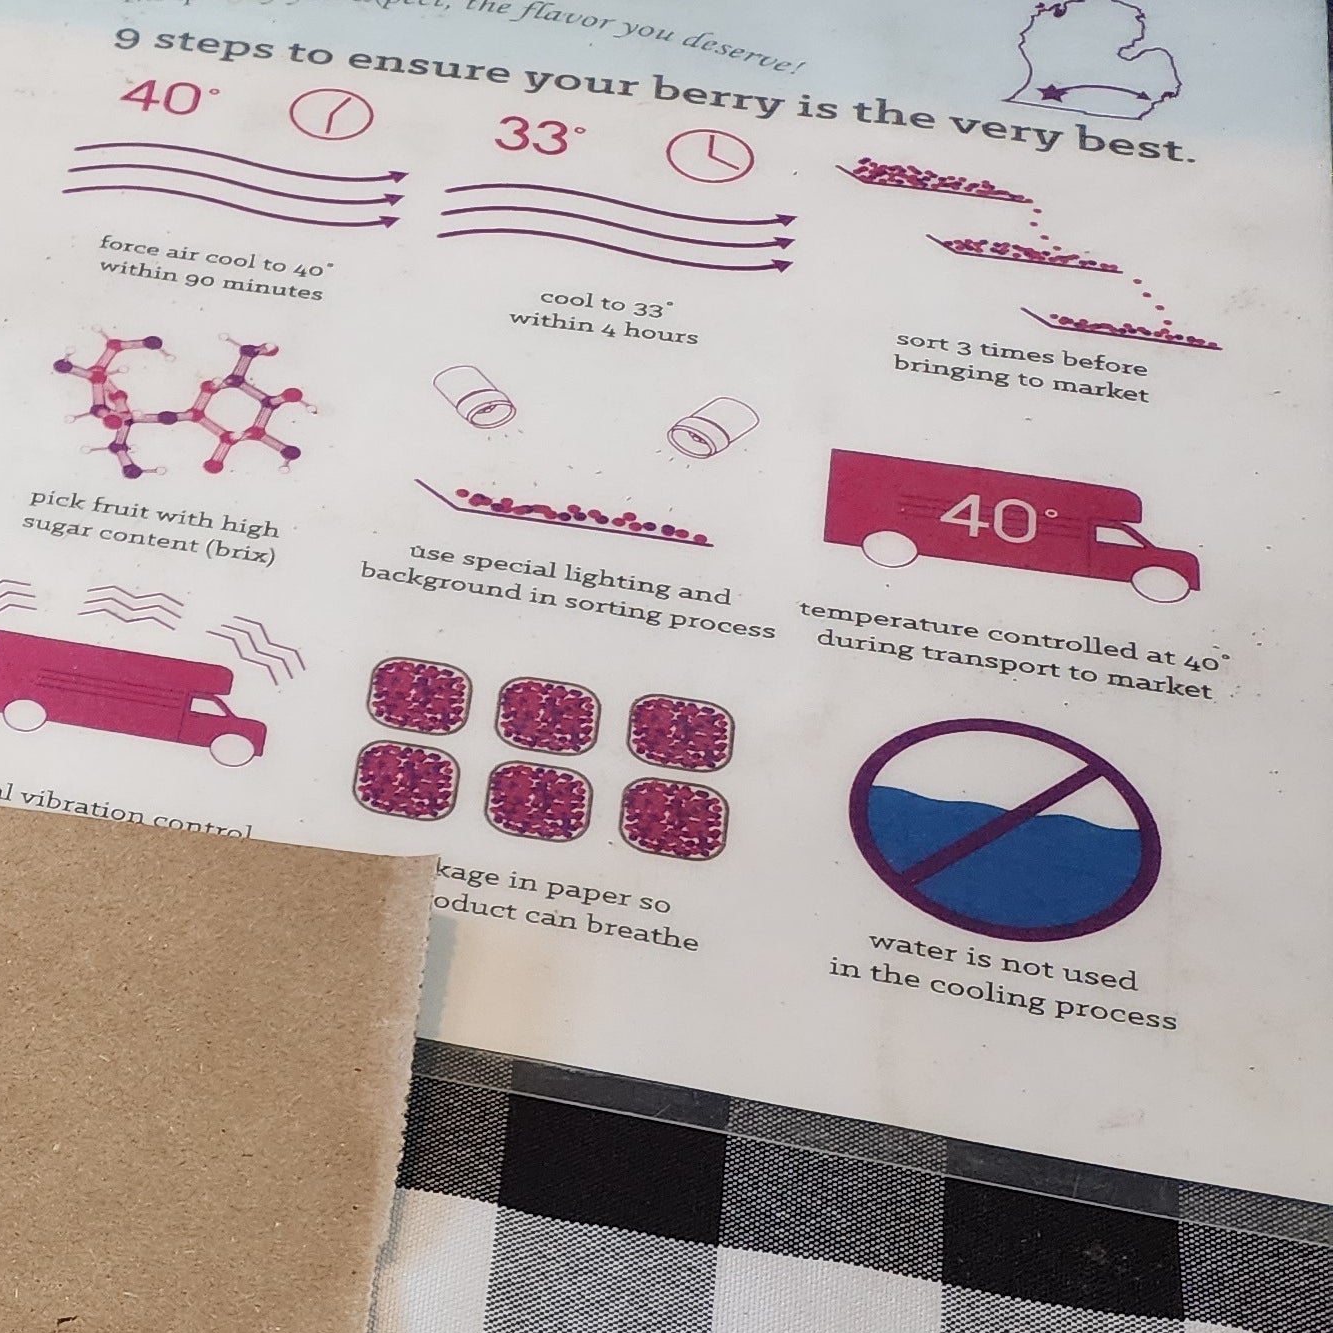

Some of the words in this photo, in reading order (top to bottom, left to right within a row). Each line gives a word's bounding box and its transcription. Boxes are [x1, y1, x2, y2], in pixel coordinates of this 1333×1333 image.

[510, 1, 615, 29] flavor
[614, 22, 674, 41] you
[682, 32, 806, 74] deserve!
[115, 28, 140, 49] 9
[155, 33, 273, 62] steps
[289, 44, 333, 64] to
[349, 54, 510, 83] ensure
[525, 71, 639, 96] your
[653, 75, 785, 119] berry
[798, 95, 837, 119] is
[853, 98, 935, 129] the
[949, 117, 1063, 152] very
[1076, 124, 1195, 163] best.
[100, 235, 159, 256] force
[166, 249, 199, 261] air
[206, 254, 255, 268] cool
[264, 259, 286, 272] to
[101, 262, 177, 282] within
[185, 274, 214, 287] 90
[223, 280, 322, 300] minutes
[541, 293, 593, 308] cool
[601, 298, 625, 311] to
[510, 313, 593, 332] within
[602, 324, 615, 337] 4
[624, 322, 698, 344] hours
[895, 354, 1009, 387] bringing
[1018, 374, 1044, 387] to
[1054, 380, 1148, 403] market
[897, 335, 948, 351] sort
[957, 342, 971, 355] 3
[981, 344, 1054, 363] times
[1063, 350, 1147, 376] before
[30, 493, 85, 509] pick
[93, 497, 149, 519] fruit
[157, 511, 212, 528] with
[221, 515, 278, 539] high
[23, 518, 93, 537] sugar
[100, 530, 198, 552] content
[206, 539, 275, 567] (brix)
[361, 560, 523, 601] background
[530, 592, 556, 606] in
[565, 598, 662, 626] sorting
[669, 614, 775, 638] process
[411, 546, 454, 562] use
[463, 555, 555, 578] special
[565, 564, 671, 600] lighting
[679, 588, 730, 605] and
[800, 602, 980, 639] temperature
[988, 630, 1138, 660] controlled
[1147, 651, 1175, 665] at
[818, 629, 914, 661] during
[923, 646, 1060, 677] transport
[1069, 666, 1097, 682] to
[1108, 674, 1212, 699] market
[20, 789, 144, 825] vibration
[509, 876, 537, 891] in
[546, 882, 631, 906] paper
[640, 898, 670, 913] so
[434, 894, 516, 920] oduct
[526, 911, 577, 929] can
[588, 913, 698, 951] breathe
[870, 936, 957, 962] water
[967, 947, 991, 967] is
[1002, 958, 1053, 978] not
[1063, 968, 1138, 991] used
[830, 957, 860, 978] in
[871, 963, 919, 987] the
[931, 980, 1045, 1015] cooling
[1055, 1001, 1176, 1030] process
